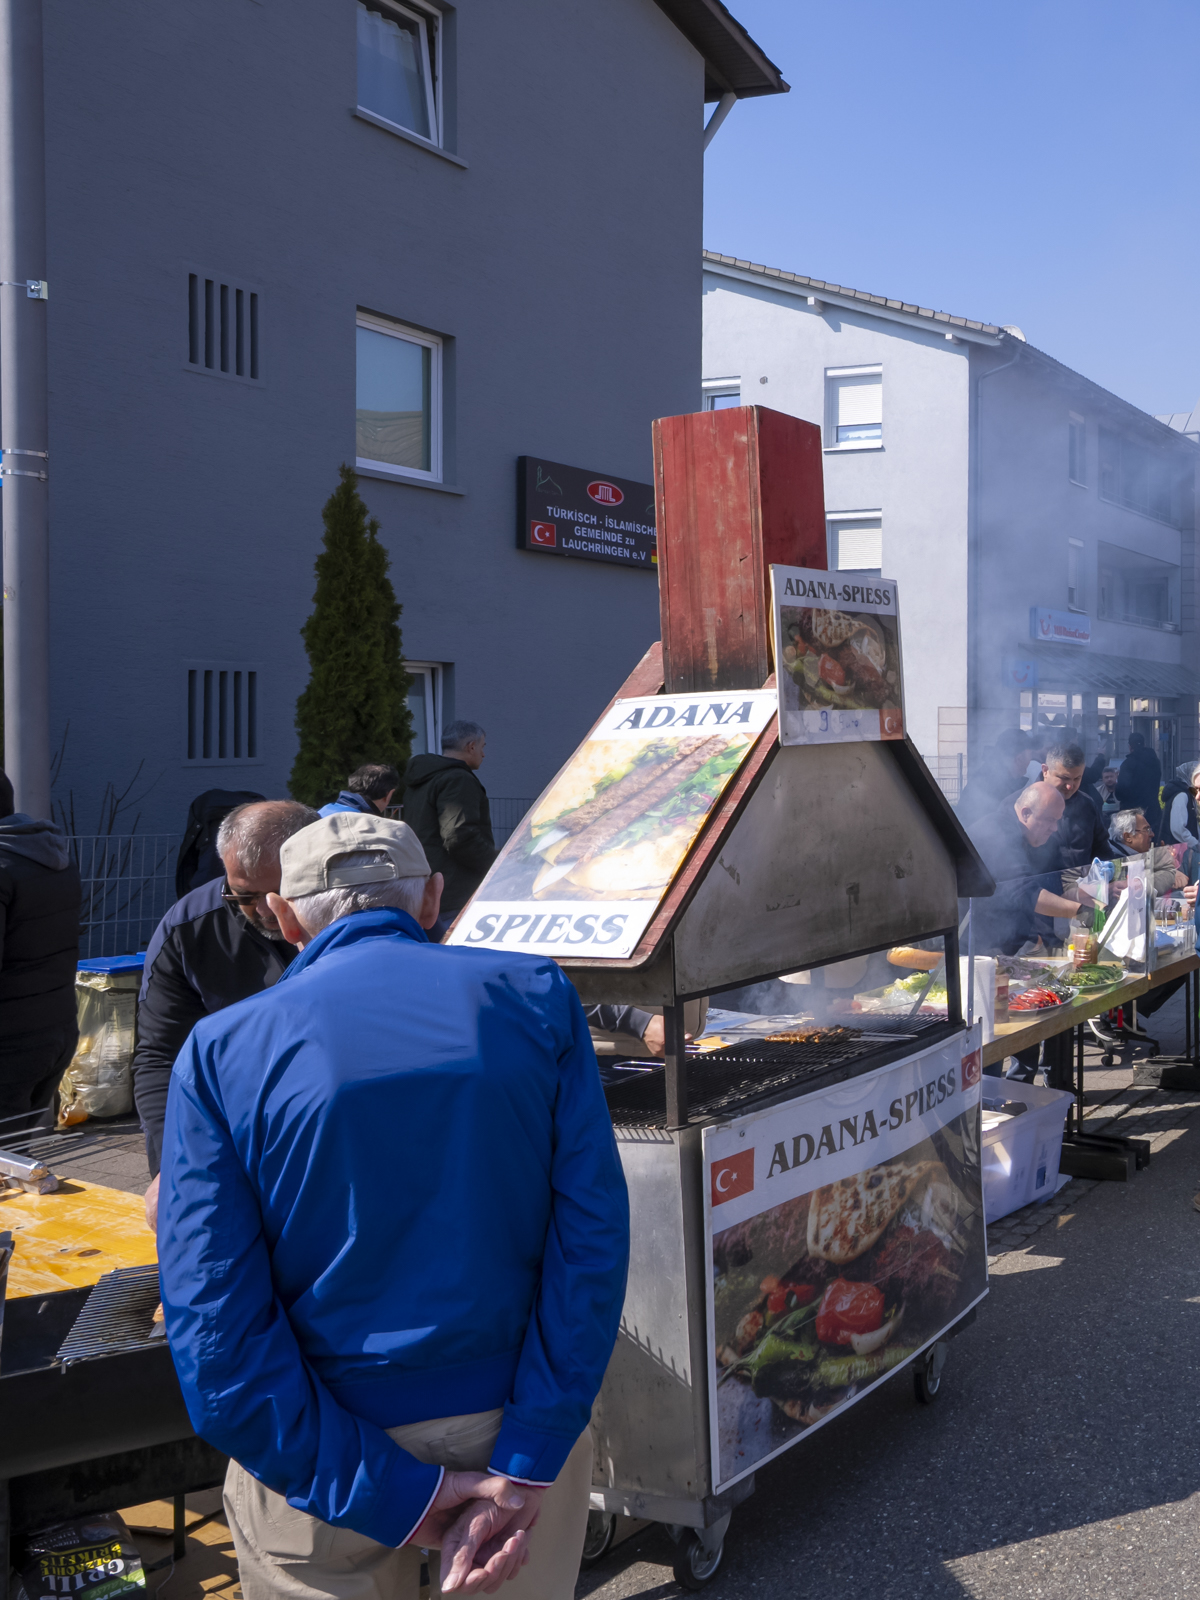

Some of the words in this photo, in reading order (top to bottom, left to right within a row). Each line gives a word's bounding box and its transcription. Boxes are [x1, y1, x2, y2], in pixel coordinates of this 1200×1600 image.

[625, 537, 635, 546] zu
[783, 577, 891, 606] ADANA-SPIESS
[613, 701, 754, 731] ADANA
[464, 914, 630, 944] SPIESS
[766, 1067, 956, 1180] ADANA-SPIESS
[41, 1558, 125, 1592] GRILL
